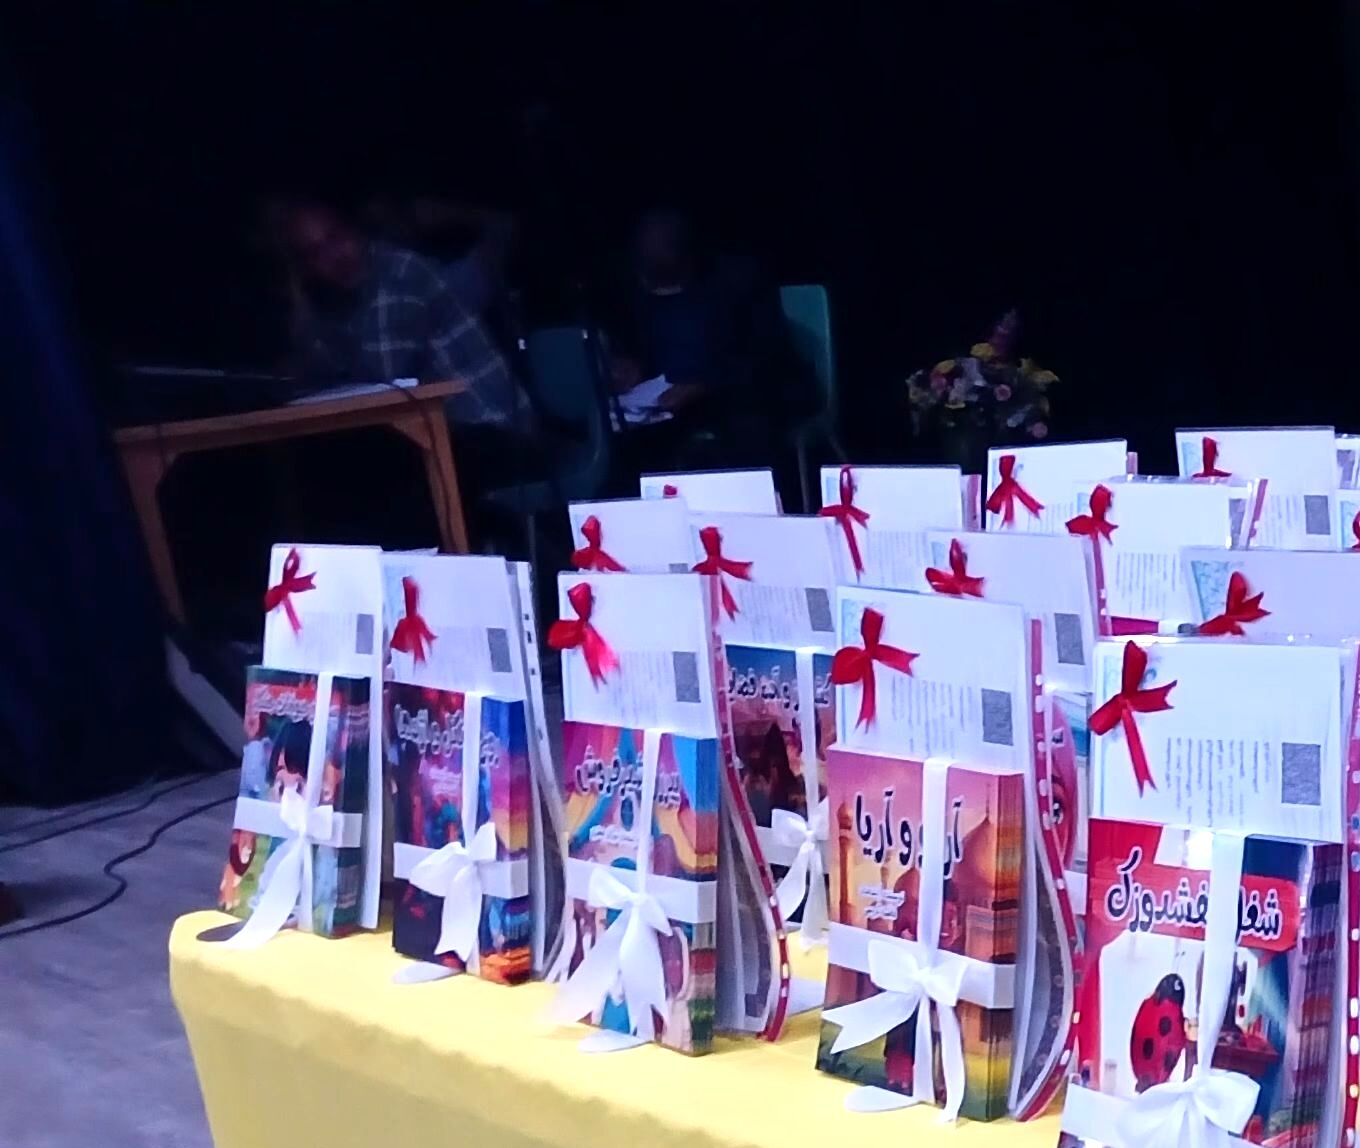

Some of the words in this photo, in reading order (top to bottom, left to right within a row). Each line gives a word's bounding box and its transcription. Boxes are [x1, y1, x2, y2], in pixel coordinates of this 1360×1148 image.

[856, 790, 893, 864] آریا
[899, 820, 912, 867] و
[1107, 847, 1210, 932] فشدوزک
